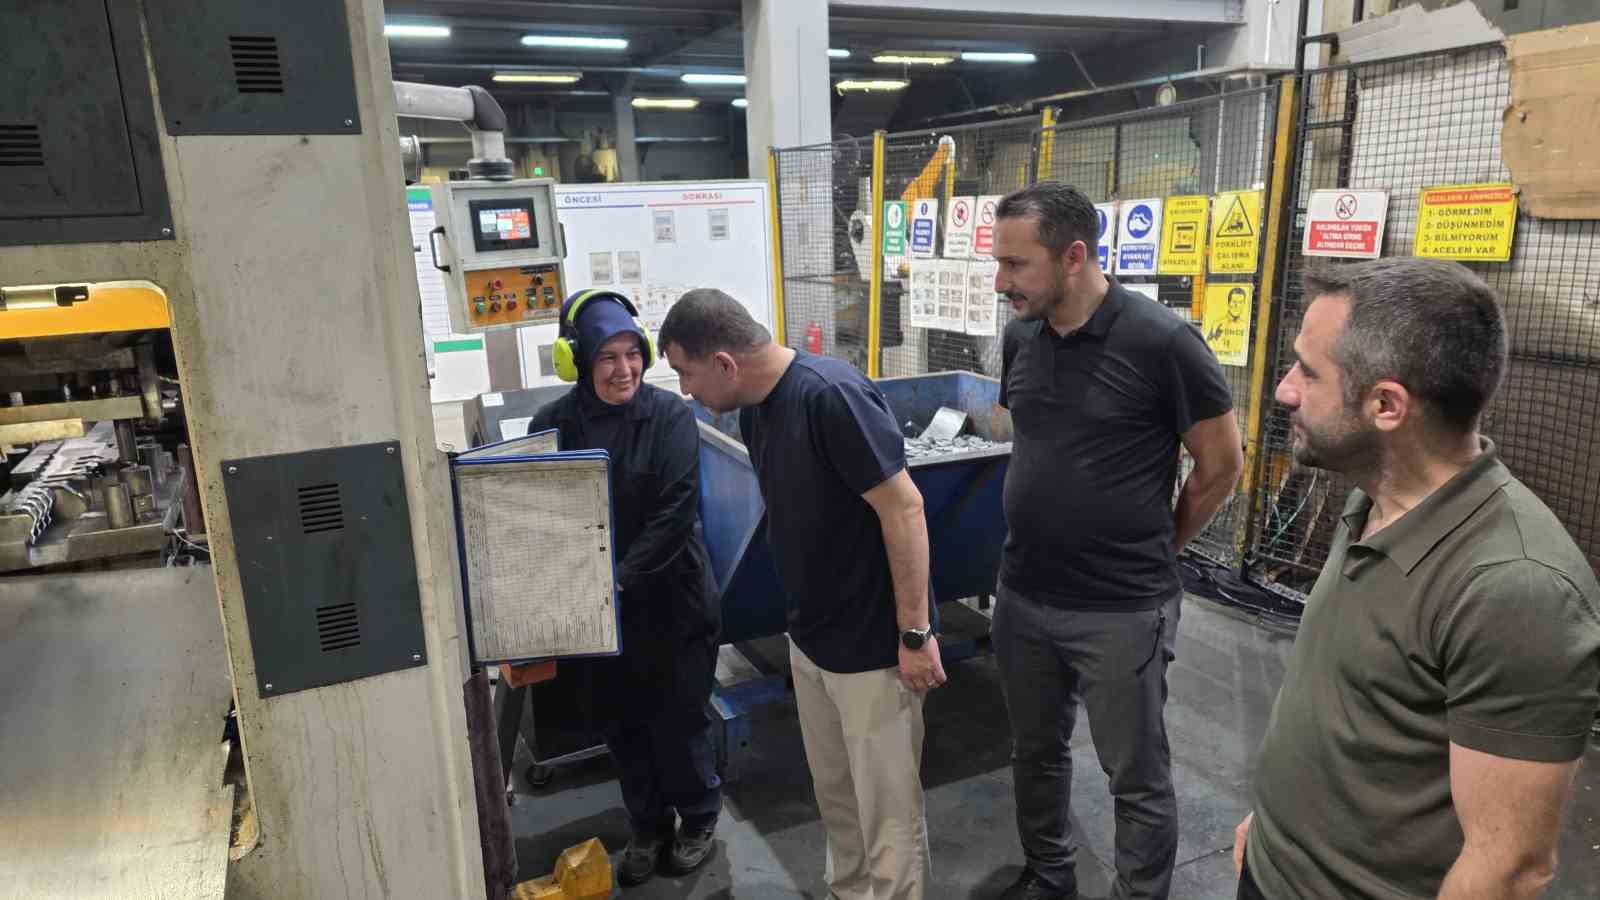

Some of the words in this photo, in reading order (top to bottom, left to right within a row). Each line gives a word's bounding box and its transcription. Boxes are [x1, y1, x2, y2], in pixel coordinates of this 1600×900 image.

[564, 193, 602, 203] ÖNCESİ
[1438, 207, 1492, 216] GÖRMEDİM
[1436, 219, 1504, 230] DÜŞÜNMEDİM
[1434, 232, 1498, 241] BİLMİYORUM
[1433, 246, 1472, 254] ACELEM
[1475, 246, 1496, 254] VAR
